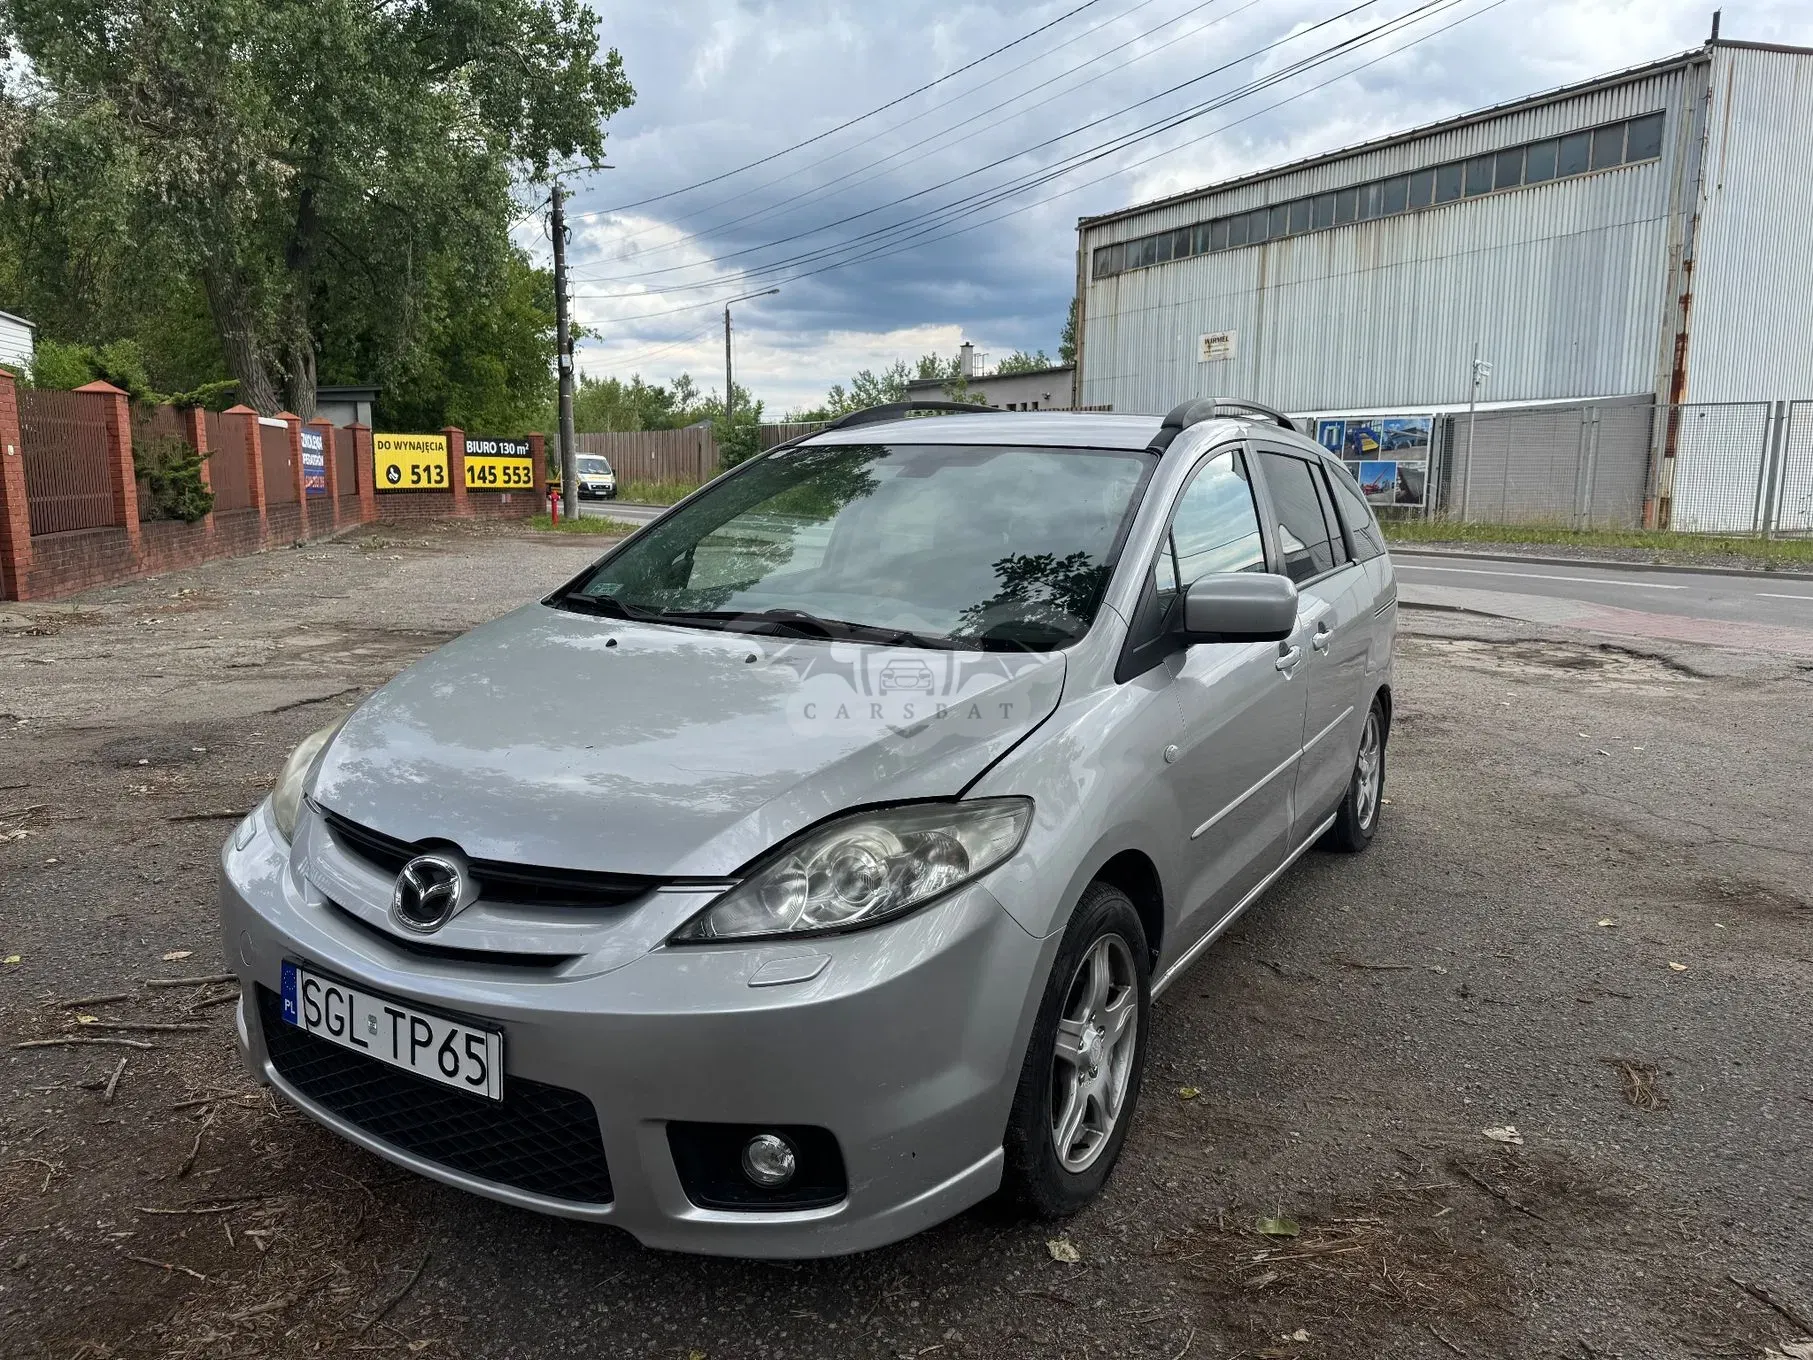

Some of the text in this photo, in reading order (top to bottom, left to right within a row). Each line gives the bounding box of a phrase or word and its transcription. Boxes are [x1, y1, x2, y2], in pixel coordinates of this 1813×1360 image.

[377, 440, 444, 453] DO WYNAJĘCIA
[466, 440, 497, 454] BIURO
[499, 442, 515, 455] 130
[411, 464, 444, 484] 513
[466, 465, 531, 484] 145 553
[284, 998, 296, 1015] PL
[303, 978, 487, 1086] SGL TP65
